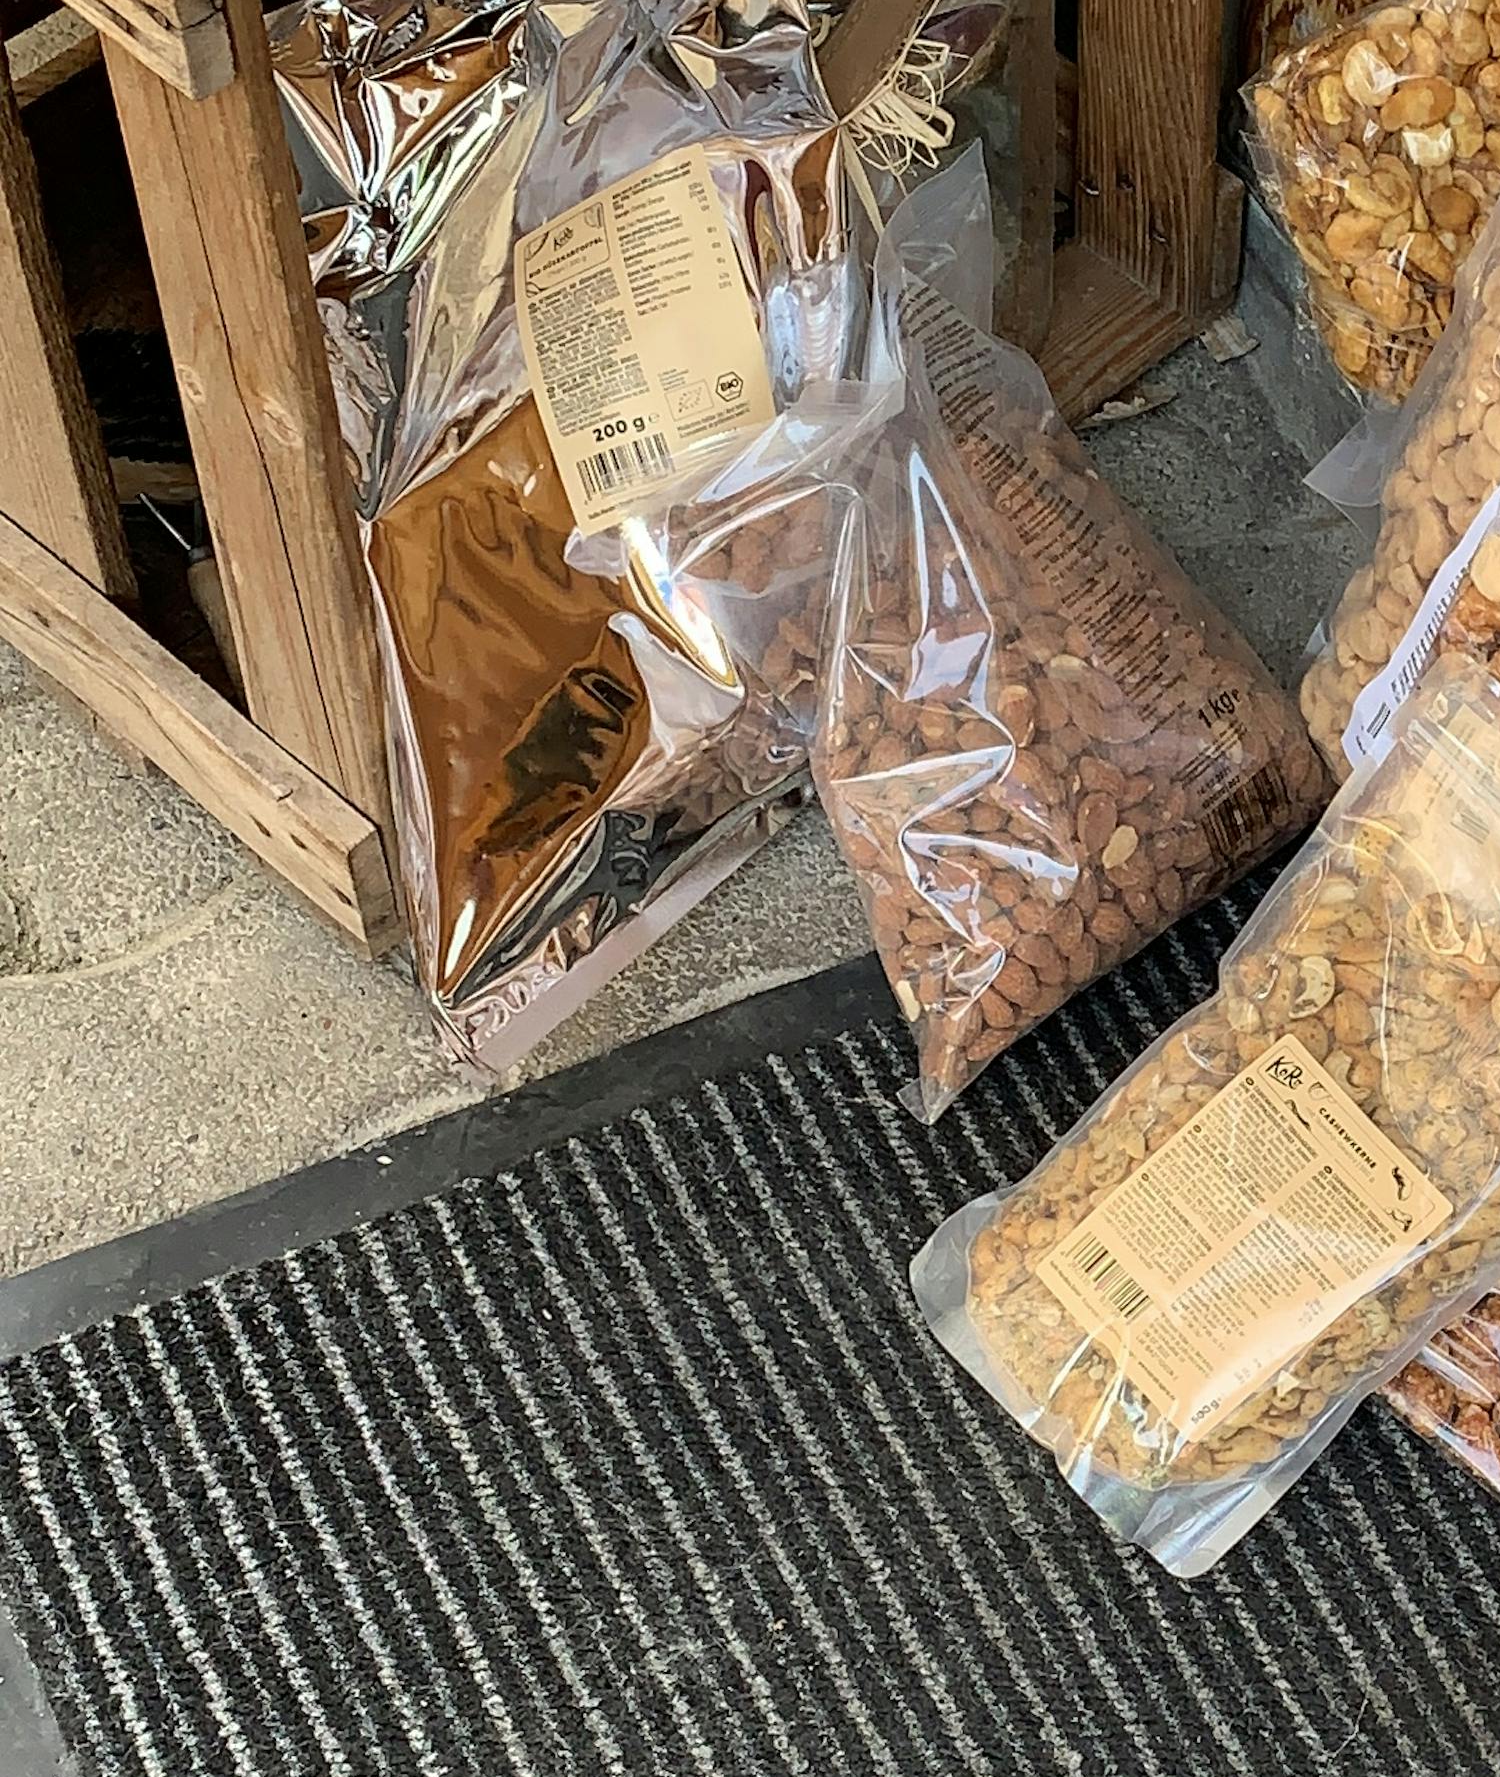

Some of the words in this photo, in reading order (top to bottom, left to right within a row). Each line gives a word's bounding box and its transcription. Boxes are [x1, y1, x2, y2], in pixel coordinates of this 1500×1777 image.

[592, 418, 628, 443] 200
[631, 416, 646, 433] g
[1268, 1052, 1309, 1091] KoRo
[1317, 1106, 1377, 1169] CASHEWKERNE
[1189, 1403, 1211, 1425] 500
